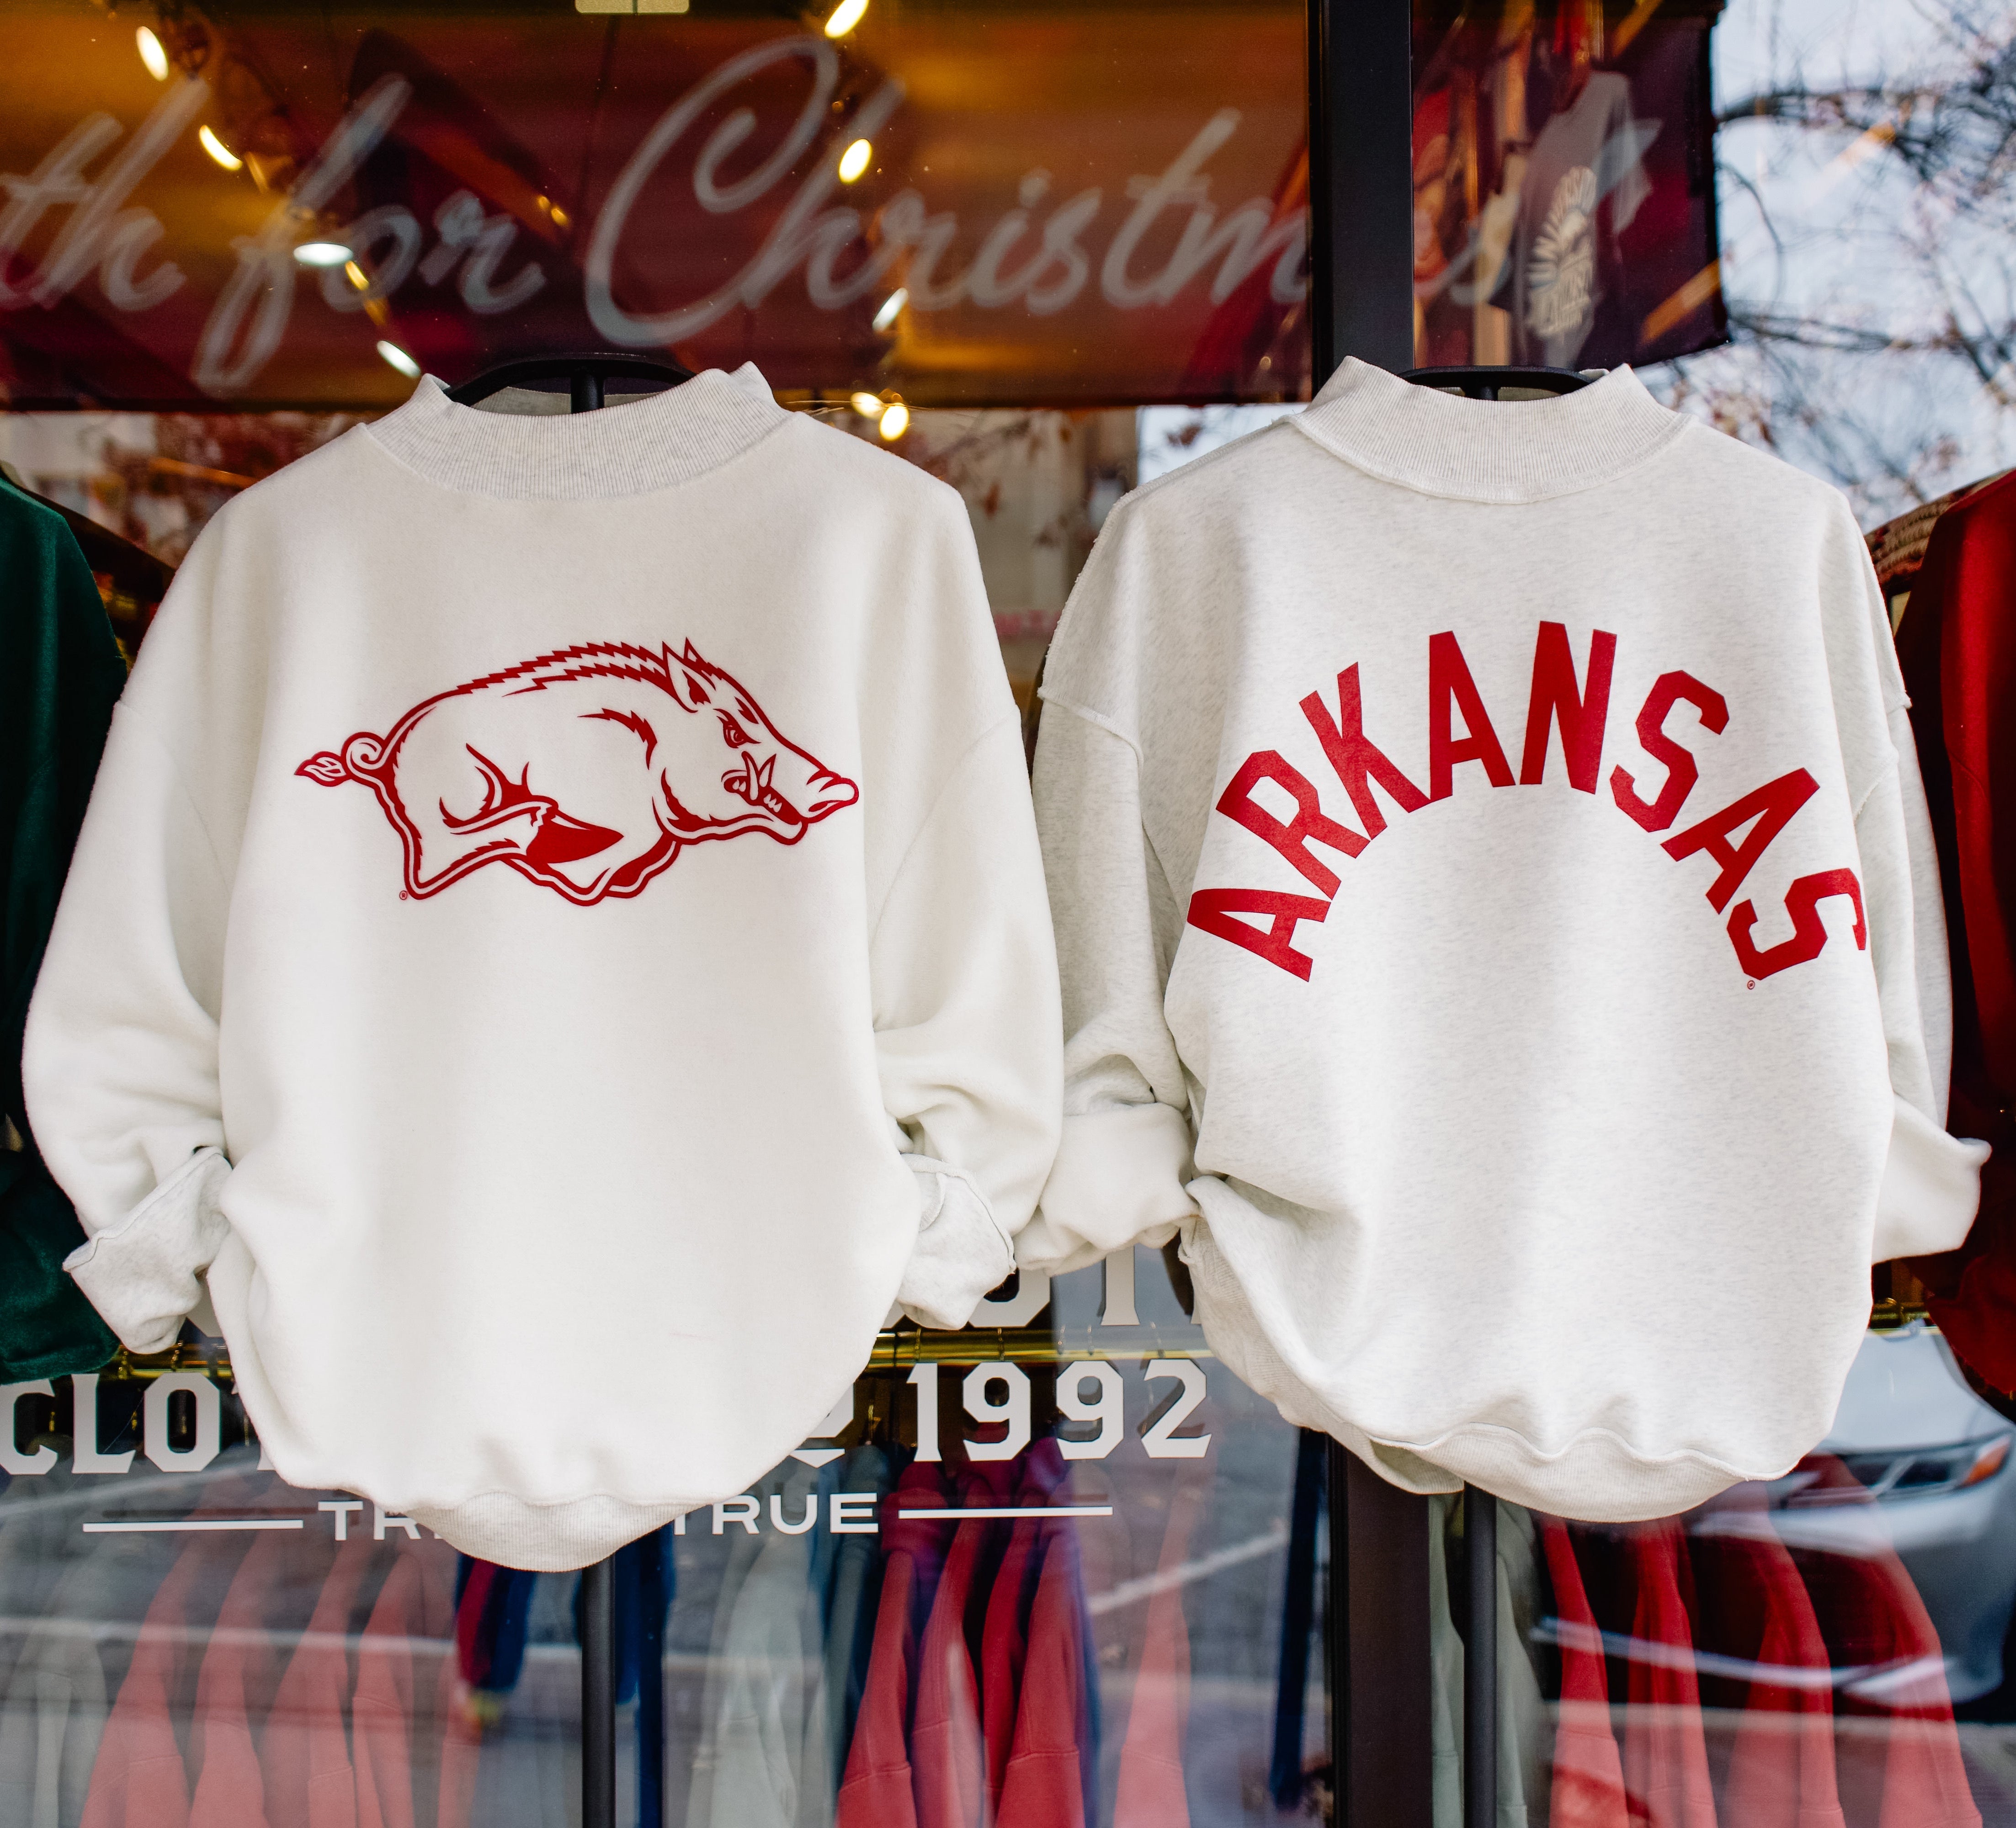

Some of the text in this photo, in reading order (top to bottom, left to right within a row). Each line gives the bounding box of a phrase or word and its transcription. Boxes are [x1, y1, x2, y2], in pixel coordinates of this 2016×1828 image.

[192, 74, 547, 394] for
[1187, 621, 1866, 981] ARKANSAS
[906, 1358, 1212, 1462] 1992
